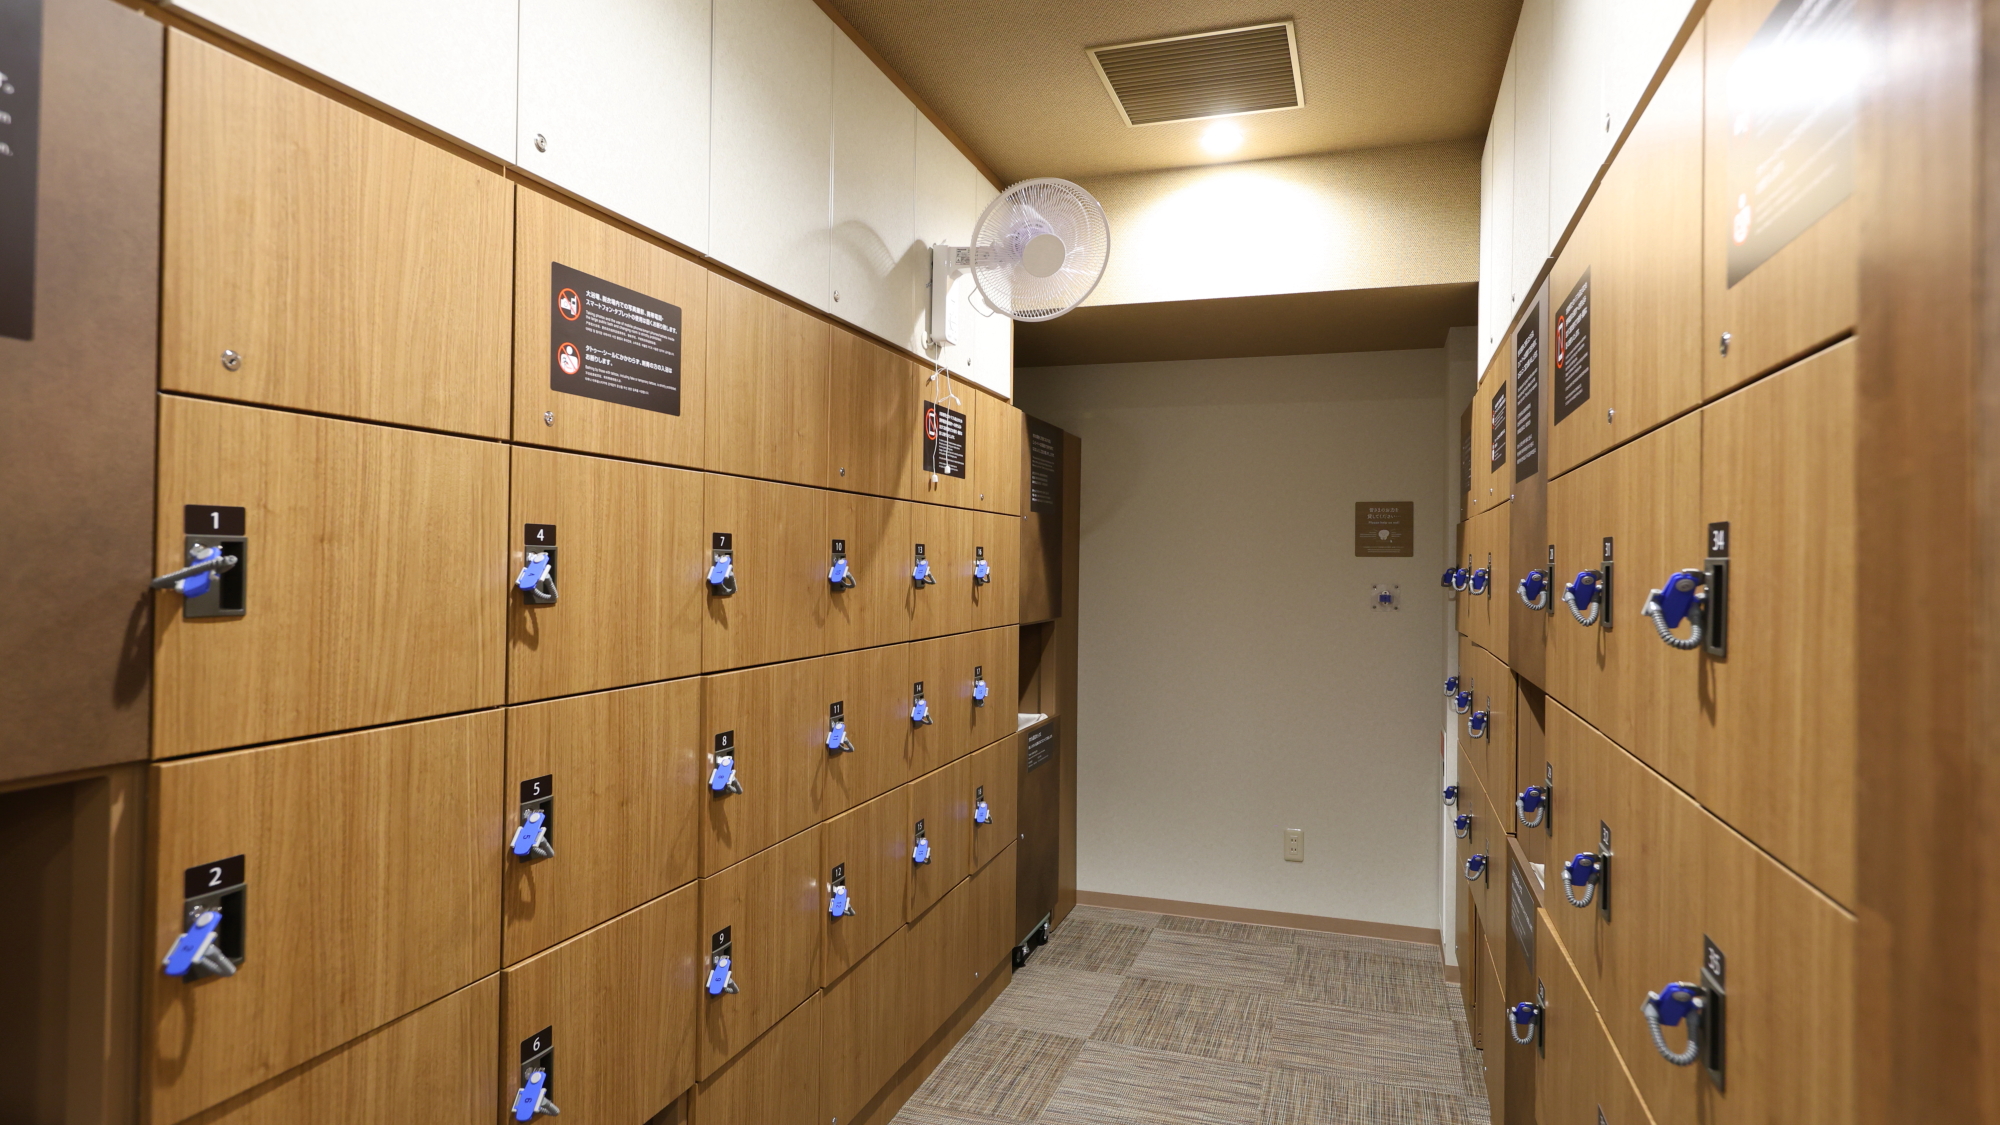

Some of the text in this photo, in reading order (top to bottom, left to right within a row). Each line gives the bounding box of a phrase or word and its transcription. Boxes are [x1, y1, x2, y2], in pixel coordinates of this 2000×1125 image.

[210, 511, 219, 530] 1
[536, 528, 545, 542] 4
[1711, 530, 1725, 551] 34
[720, 537, 725, 547] 7
[835, 542, 843, 551] 10
[917, 546, 923, 554] 13
[916, 684, 922, 692] 14
[834, 704, 840, 714] 11
[721, 735, 727, 746] 8
[532, 780, 541, 797] 5
[917, 822, 922, 831] 15
[208, 866, 222, 887] 2
[836, 867, 842, 877] 12
[719, 932, 725, 944] 9
[1708, 947, 1721, 976] 35
[532, 1036, 541, 1052] 6
